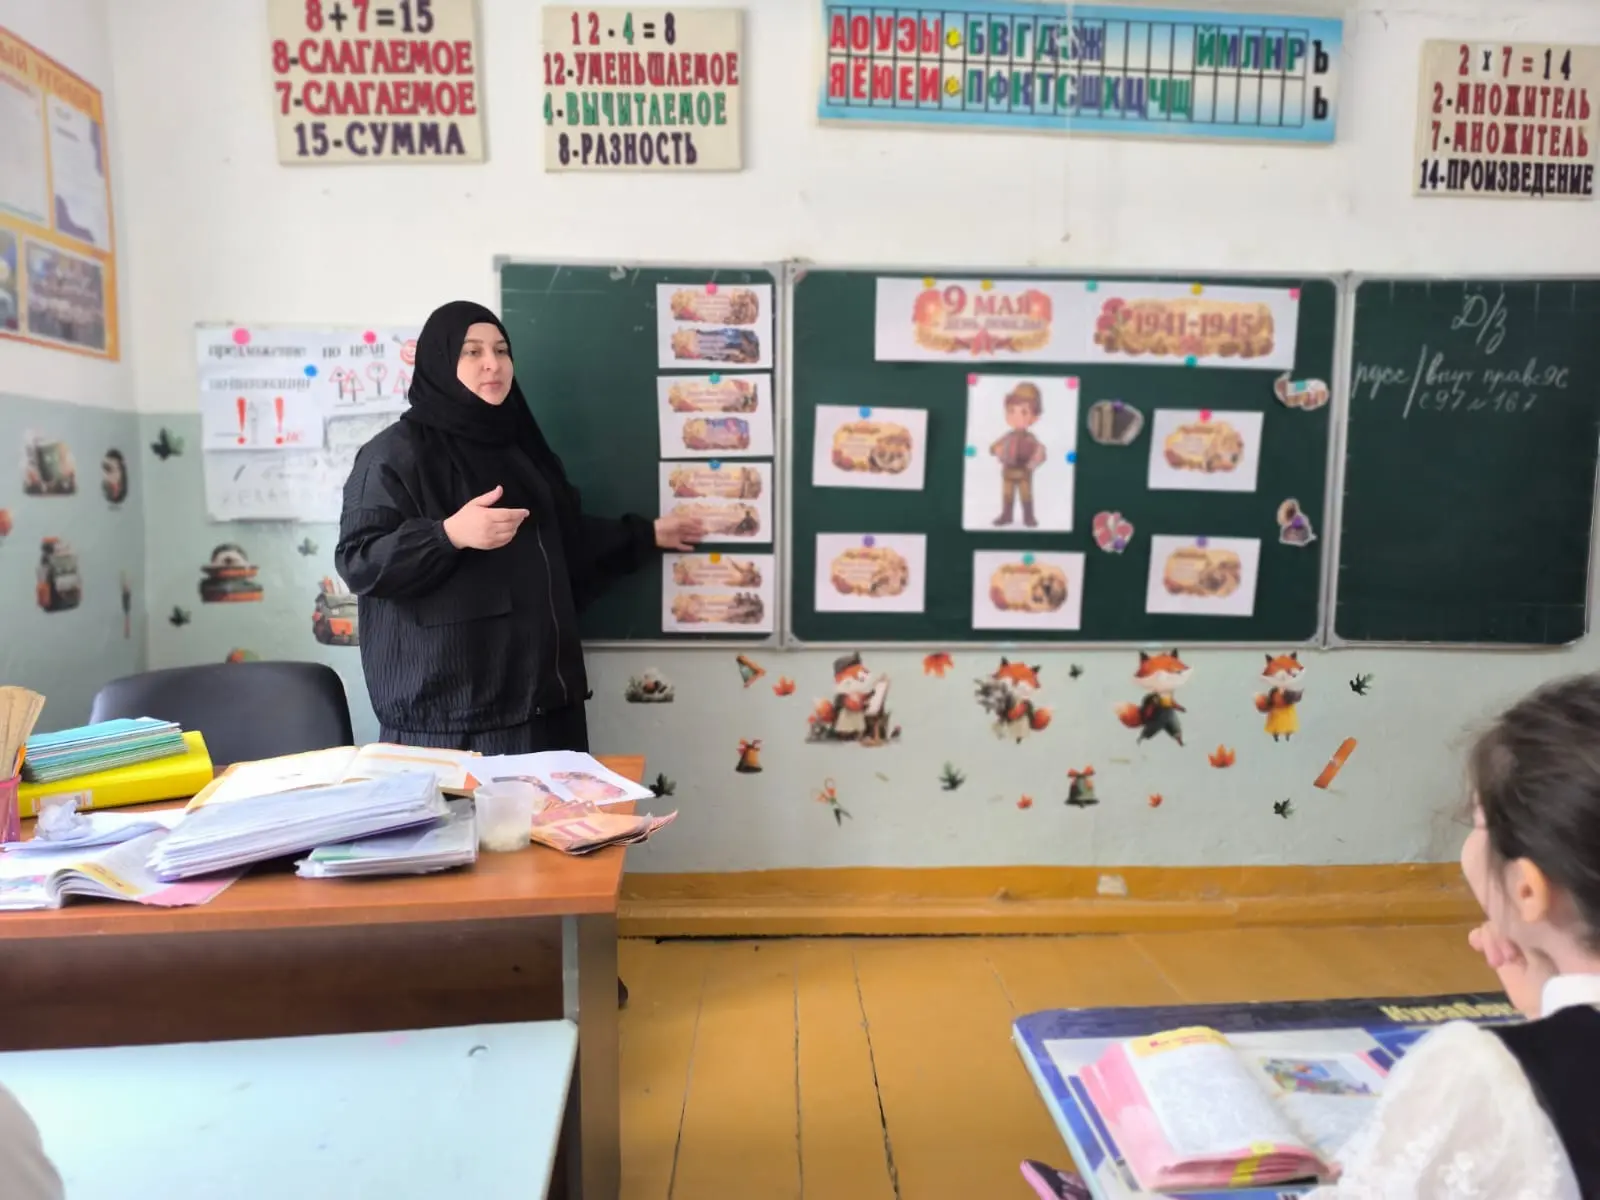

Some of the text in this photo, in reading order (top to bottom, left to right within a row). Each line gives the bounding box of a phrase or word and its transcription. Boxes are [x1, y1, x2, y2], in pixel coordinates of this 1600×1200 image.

[272, 38, 474, 75] 8-СЛАГАЕМОЕ
[543, 51, 740, 86] 12-УМЕНЬШАЕМОЕ
[275, 80, 477, 116] 7-СЛАГАЕМОЕ
[543, 91, 728, 127] 4-ВЫЧИТАЕМОЕ
[1432, 81, 1591, 120] 2-МНОЖИТЕЛЬ
[294, 121, 466, 157] 15-СУММА
[558, 131, 698, 166] 8-РАЗНОСТЬ
[1431, 120, 1589, 157] 7-МНОЖИТЕЛЬ
[1419, 158, 1594, 198] 14-ПРОИЗВЕДЕНИЕ
[943, 285, 1032, 316] 9 МАЯ
[1135, 311, 1255, 338] 1941-1945
